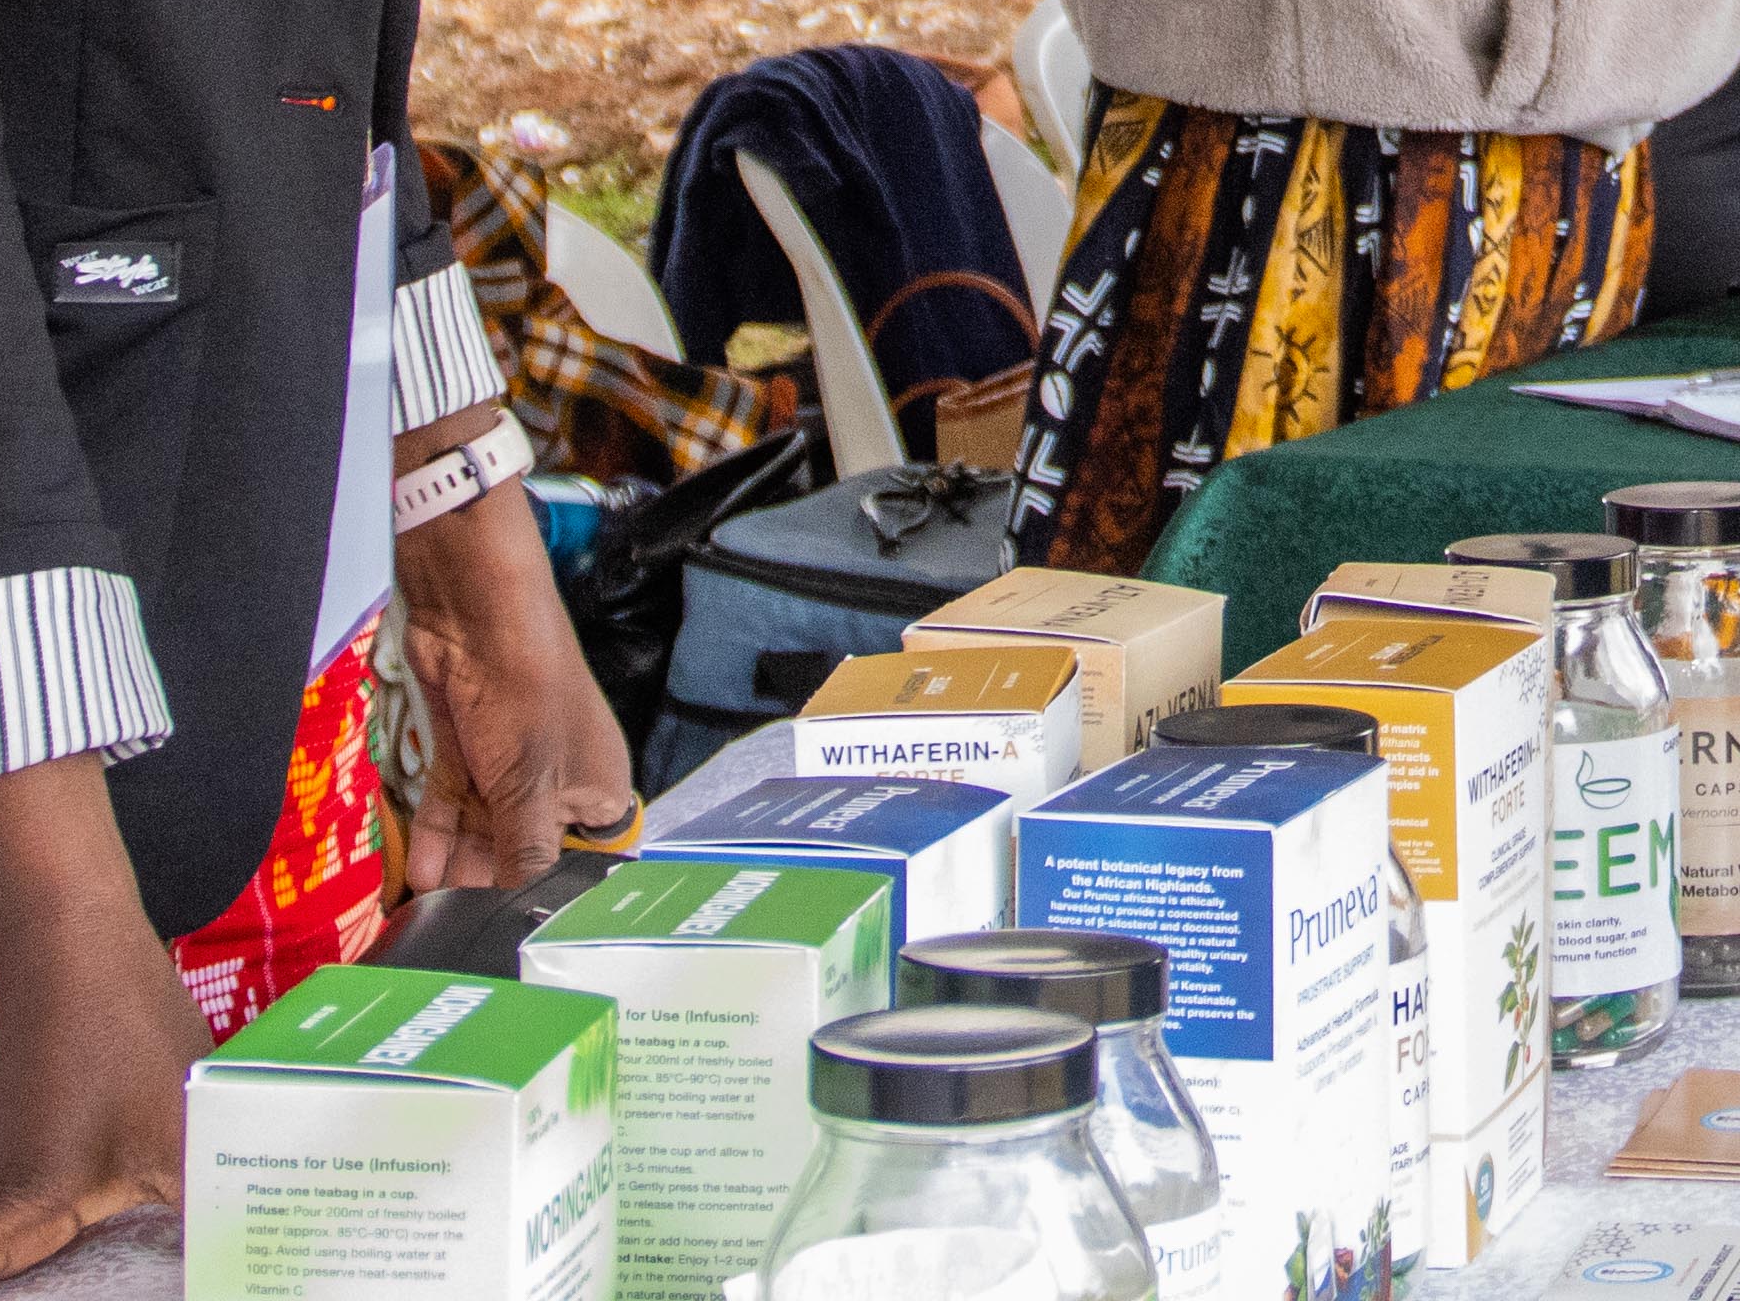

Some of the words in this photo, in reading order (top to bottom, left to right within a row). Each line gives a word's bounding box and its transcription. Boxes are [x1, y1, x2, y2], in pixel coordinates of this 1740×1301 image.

[1391, 725, 1427, 735] matrix
[822, 741, 1019, 766] WITHAFERIN-A
[1468, 734, 1541, 804] WITHAFERIN-A
[1492, 780, 1524, 828] FORTE
[1681, 806, 1739, 820] Vernonia
[1045, 856, 1054, 868] A
[1057, 857, 1098, 872] potent
[1101, 859, 1162, 874] botanical
[1165, 864, 1208, 879] legacy
[1212, 866, 1244, 878] from
[1680, 864, 1734, 879] Natural
[1071, 875, 1093, 887] the
[1096, 876, 1142, 890] African
[1145, 879, 1215, 896] Highlands.
[1084, 890, 1120, 902] Prunus
[1180, 897, 1226, 910] ethically
[1050, 901, 1101, 914] harvested
[1116, 906, 1155, 920] provide
[1167, 908, 1239, 922] concentrated
[1048, 915, 1082, 925] source
[1160, 922, 1180, 933] and
[1182, 922, 1241, 935] docosanol.
[1557, 917, 1582, 930] skin
[1585, 915, 1622, 930] clarity,
[1199, 938, 1236, 948] natural
[1559, 934, 1592, 947] blood
[1595, 931, 1628, 946] sugar,
[1630, 927, 1647, 939] and
[1210, 952, 1248, 964] urinary
[1595, 945, 1637, 960] function
[1177, 962, 1214, 975] vitality.
[1181, 982, 1222, 996] Kenyan
[1175, 995, 1236, 1007] sustainable
[626, 1009, 646, 1022] for
[652, 1010, 679, 1022] Use
[686, 1010, 759, 1024] (Infusion):
[1188, 1010, 1235, 1023] preserve
[635, 1036, 676, 1051] teabag
[704, 1040, 730, 1052] cup.
[645, 1054, 680, 1067] 200ml
[698, 1055, 735, 1069] freshly
[739, 1057, 773, 1068] boiled
[753, 1074, 771, 1085] the
[635, 1093, 664, 1107] using
[668, 1092, 706, 1107] boiling
[625, 1110, 672, 1123] preserve
[676, 1109, 754, 1122] heat-sensitive
[719, 1146, 749, 1158] allow
[216, 1153, 299, 1170] Directions
[304, 1154, 328, 1170] for
[332, 1156, 364, 1172] Use
[369, 1157, 451, 1175] (Infusion):
[246, 1183, 277, 1197] Place
[281, 1186, 310, 1197] one
[313, 1185, 359, 1201] teabag
[390, 1190, 418, 1204] cup.
[629, 1181, 664, 1196] Gently
[668, 1184, 699, 1196] press
[724, 1183, 762, 1197] teabag
[768, 1182, 789, 1194] with
[634, 1199, 674, 1211] release
[698, 1200, 773, 1212] concentrated
[246, 1204, 289, 1219] Infuse:
[293, 1206, 321, 1220] Pour
[325, 1206, 364, 1221] 200ml
[383, 1209, 425, 1225] freshly
[428, 1209, 466, 1222] boiled
[246, 1225, 279, 1238] water
[283, 1224, 333, 1243] (approx.
[411, 1229, 439, 1242] over
[444, 1228, 464, 1241] the
[684, 1236, 718, 1251] honey
[246, 1244, 273, 1261] bag.
[276, 1244, 309, 1258] Avoid
[313, 1245, 347, 1263] using
[351, 1246, 392, 1264] boiling
[395, 1249, 431, 1262] water
[634, 1252, 674, 1265] Intake:
[678, 1254, 709, 1270] Enjoy
[303, 1266, 355, 1283] preserve
[359, 1266, 445, 1281] heat-sensitive
[667, 1273, 714, 1287] morning
[245, 1282, 285, 1296] Vitamin
